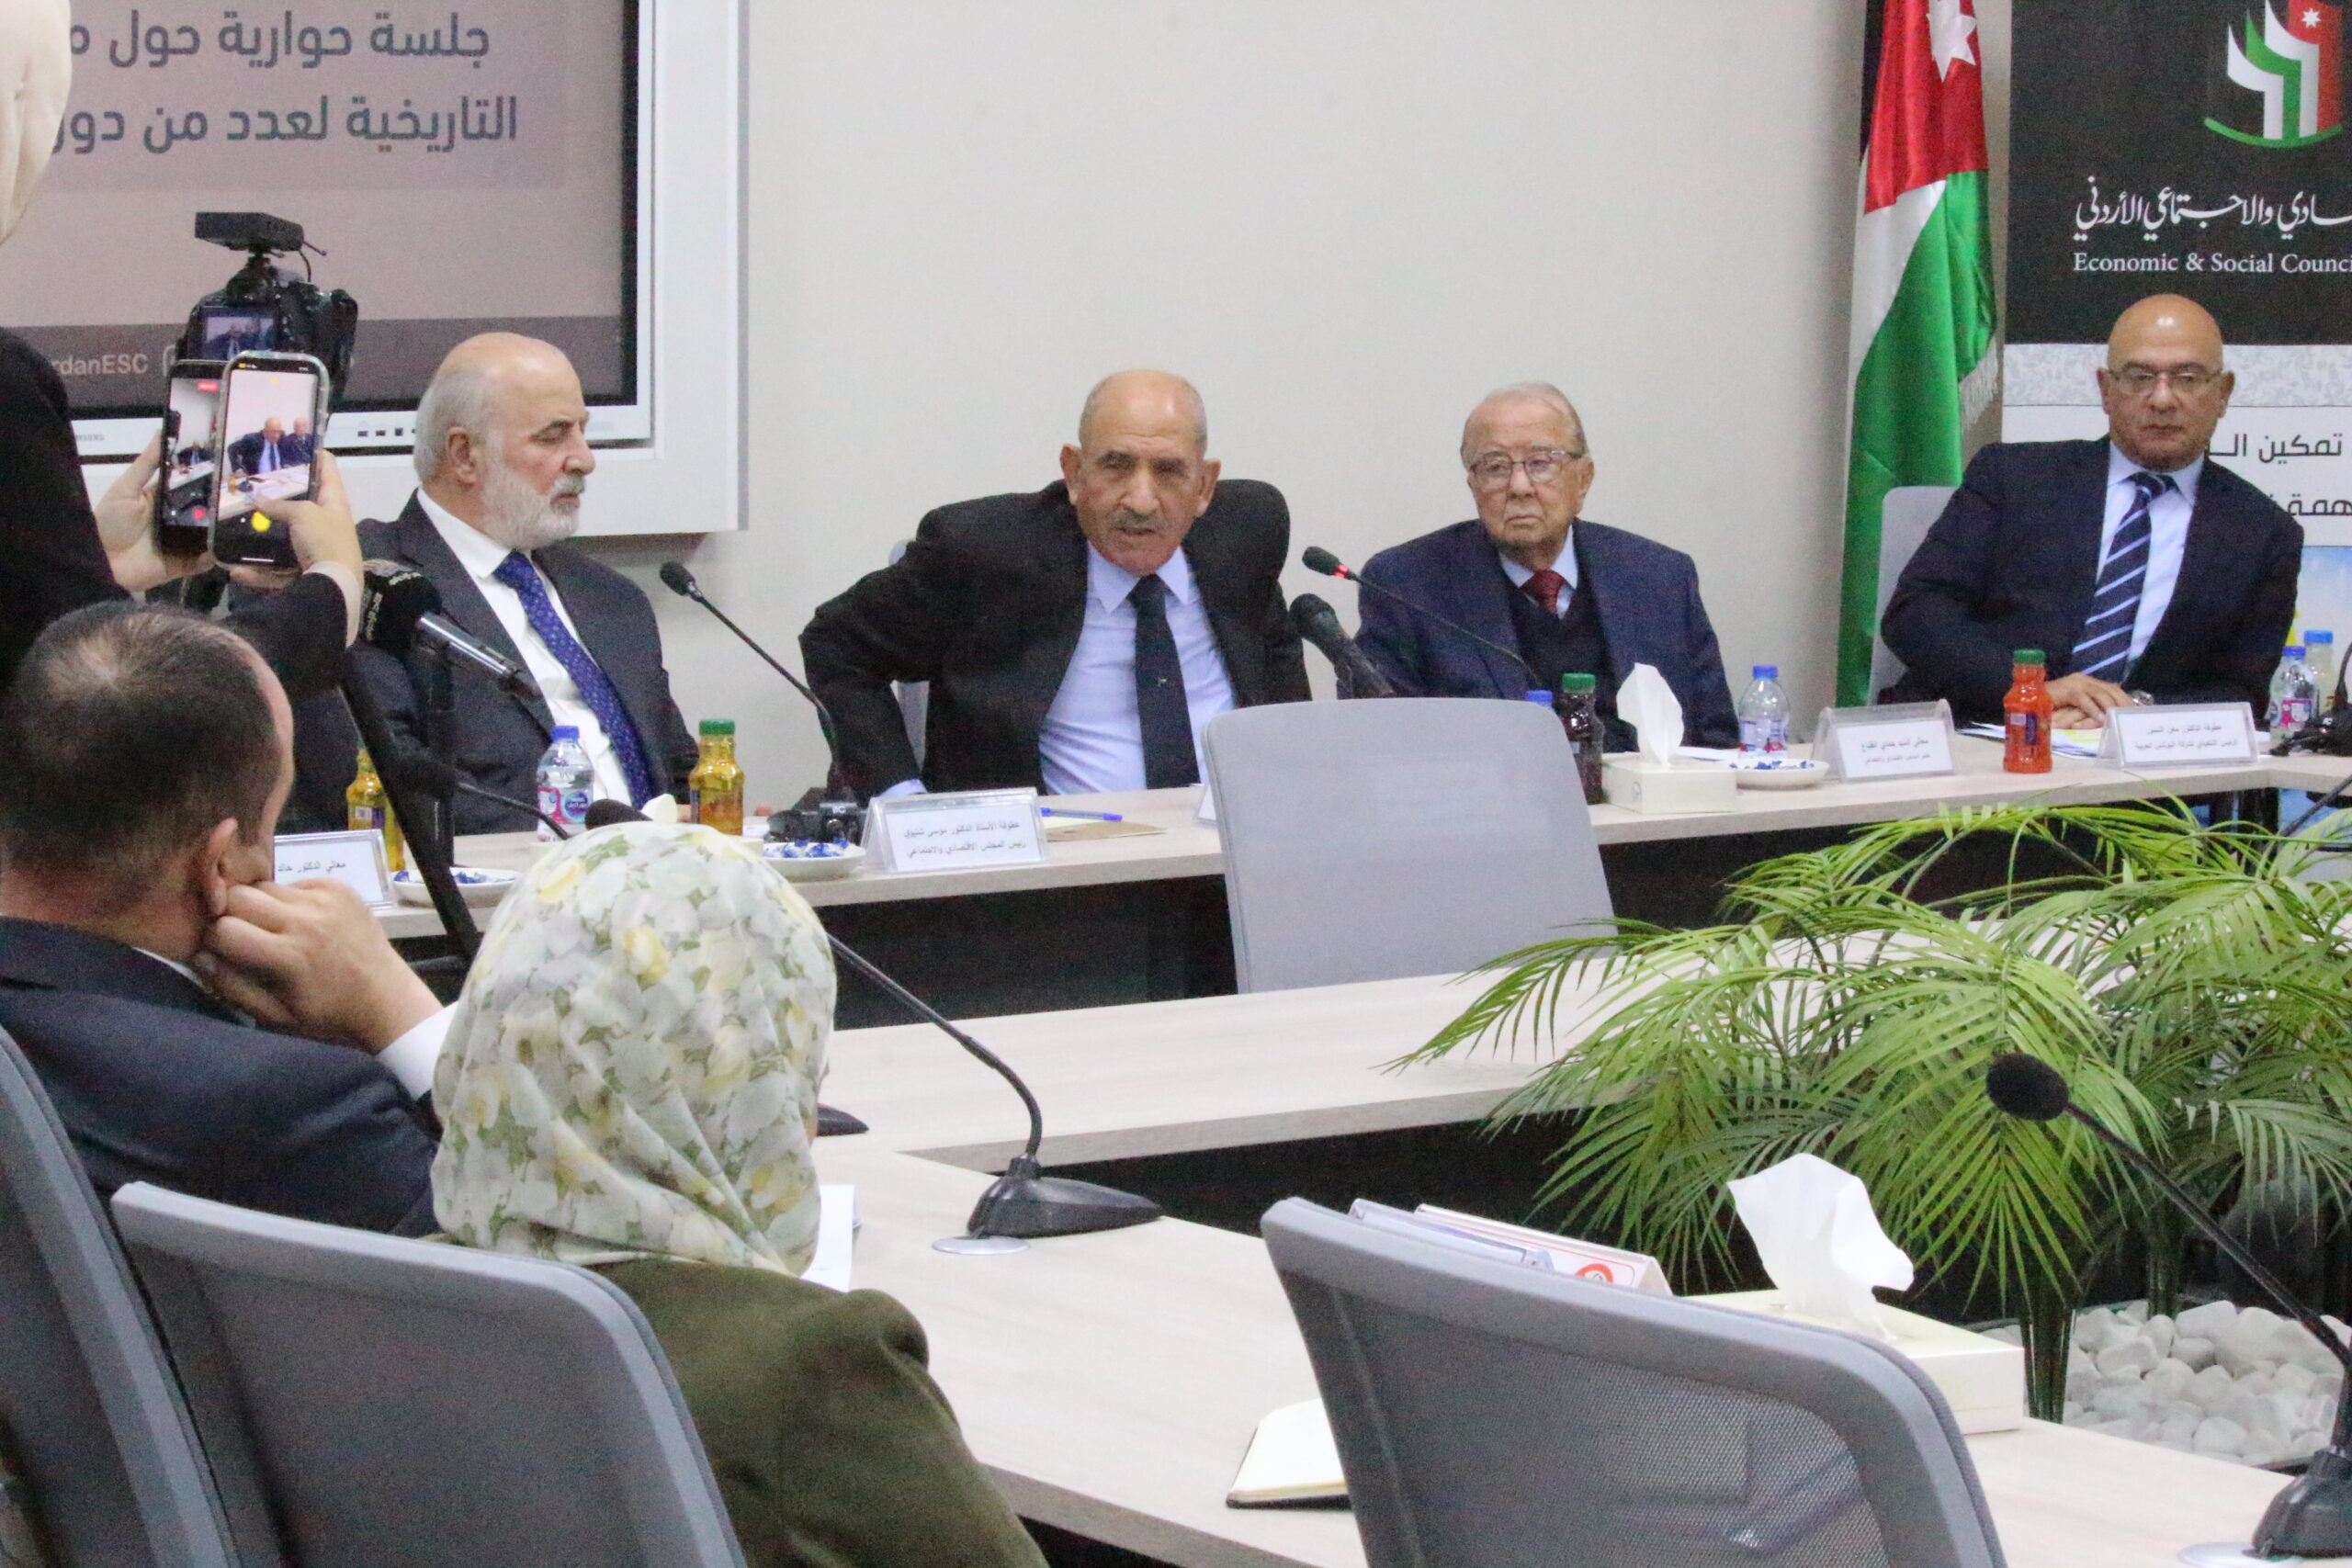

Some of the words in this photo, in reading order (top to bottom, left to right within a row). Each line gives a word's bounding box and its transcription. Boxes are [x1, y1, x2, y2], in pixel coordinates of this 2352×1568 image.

[108, 9, 201, 68] حول
[218, 9, 353, 69] حوارية
[370, 11, 490, 69] جلسة
[143, 107, 208, 154] من
[226, 95, 328, 141] لعدد
[346, 95, 517, 153] التاريخية
[2073, 253, 2178, 272] Economic
[2185, 253, 2204, 272] &
[2211, 253, 2274, 273] Social
[2280, 253, 2352, 274] Counc
[51, 353, 149, 377] rdanESC
[2258, 433, 2343, 464] تمكين
